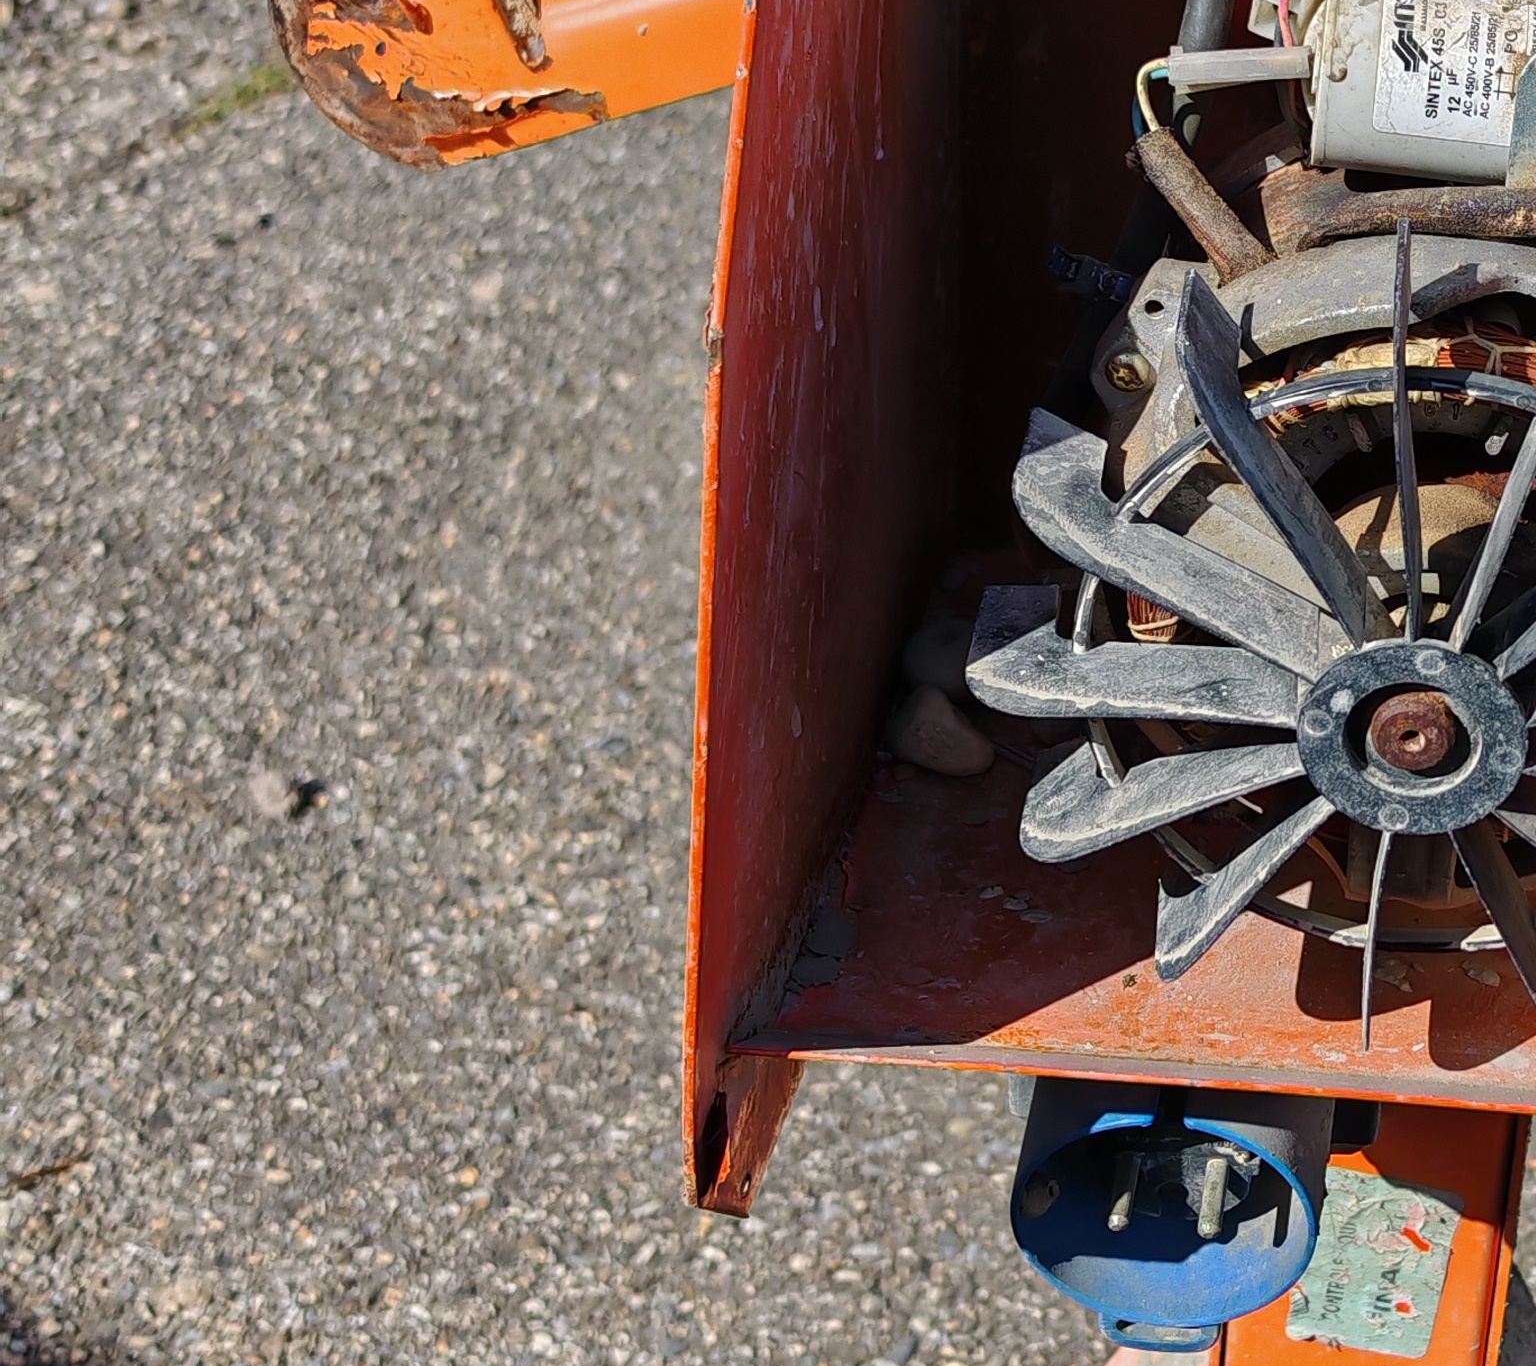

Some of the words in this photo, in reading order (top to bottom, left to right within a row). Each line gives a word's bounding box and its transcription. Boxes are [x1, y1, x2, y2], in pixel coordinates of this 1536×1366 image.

[1431, 27, 1446, 57] 45S
[1463, 100, 1474, 117] AC
[1469, 11, 1481, 53] 25/85/21
[1482, 57, 1495, 100] 400V-B
[1425, 60, 1444, 119] SINTEX
[1447, 96, 1461, 114] 12
[1480, 102, 1491, 120] AC
